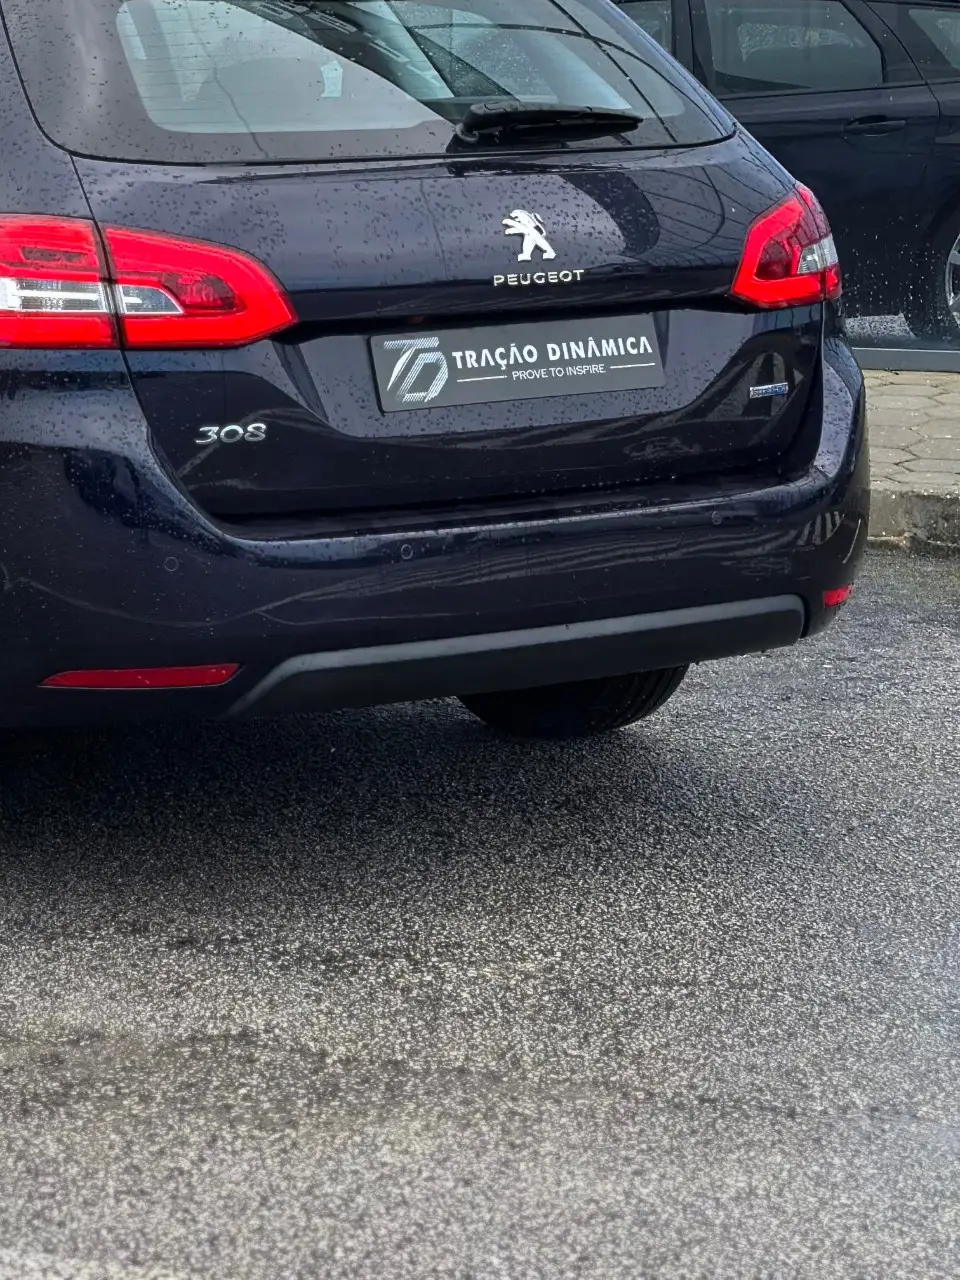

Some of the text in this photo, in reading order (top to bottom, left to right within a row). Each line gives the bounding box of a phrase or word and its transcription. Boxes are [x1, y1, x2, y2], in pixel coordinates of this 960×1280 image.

[493, 269, 585, 286] PEUGEOT
[451, 336, 653, 370] TRAÇÃO DINÂMICA
[512, 364, 606, 381] PROVE TO INSPIRE
[195, 423, 267, 444] 308
